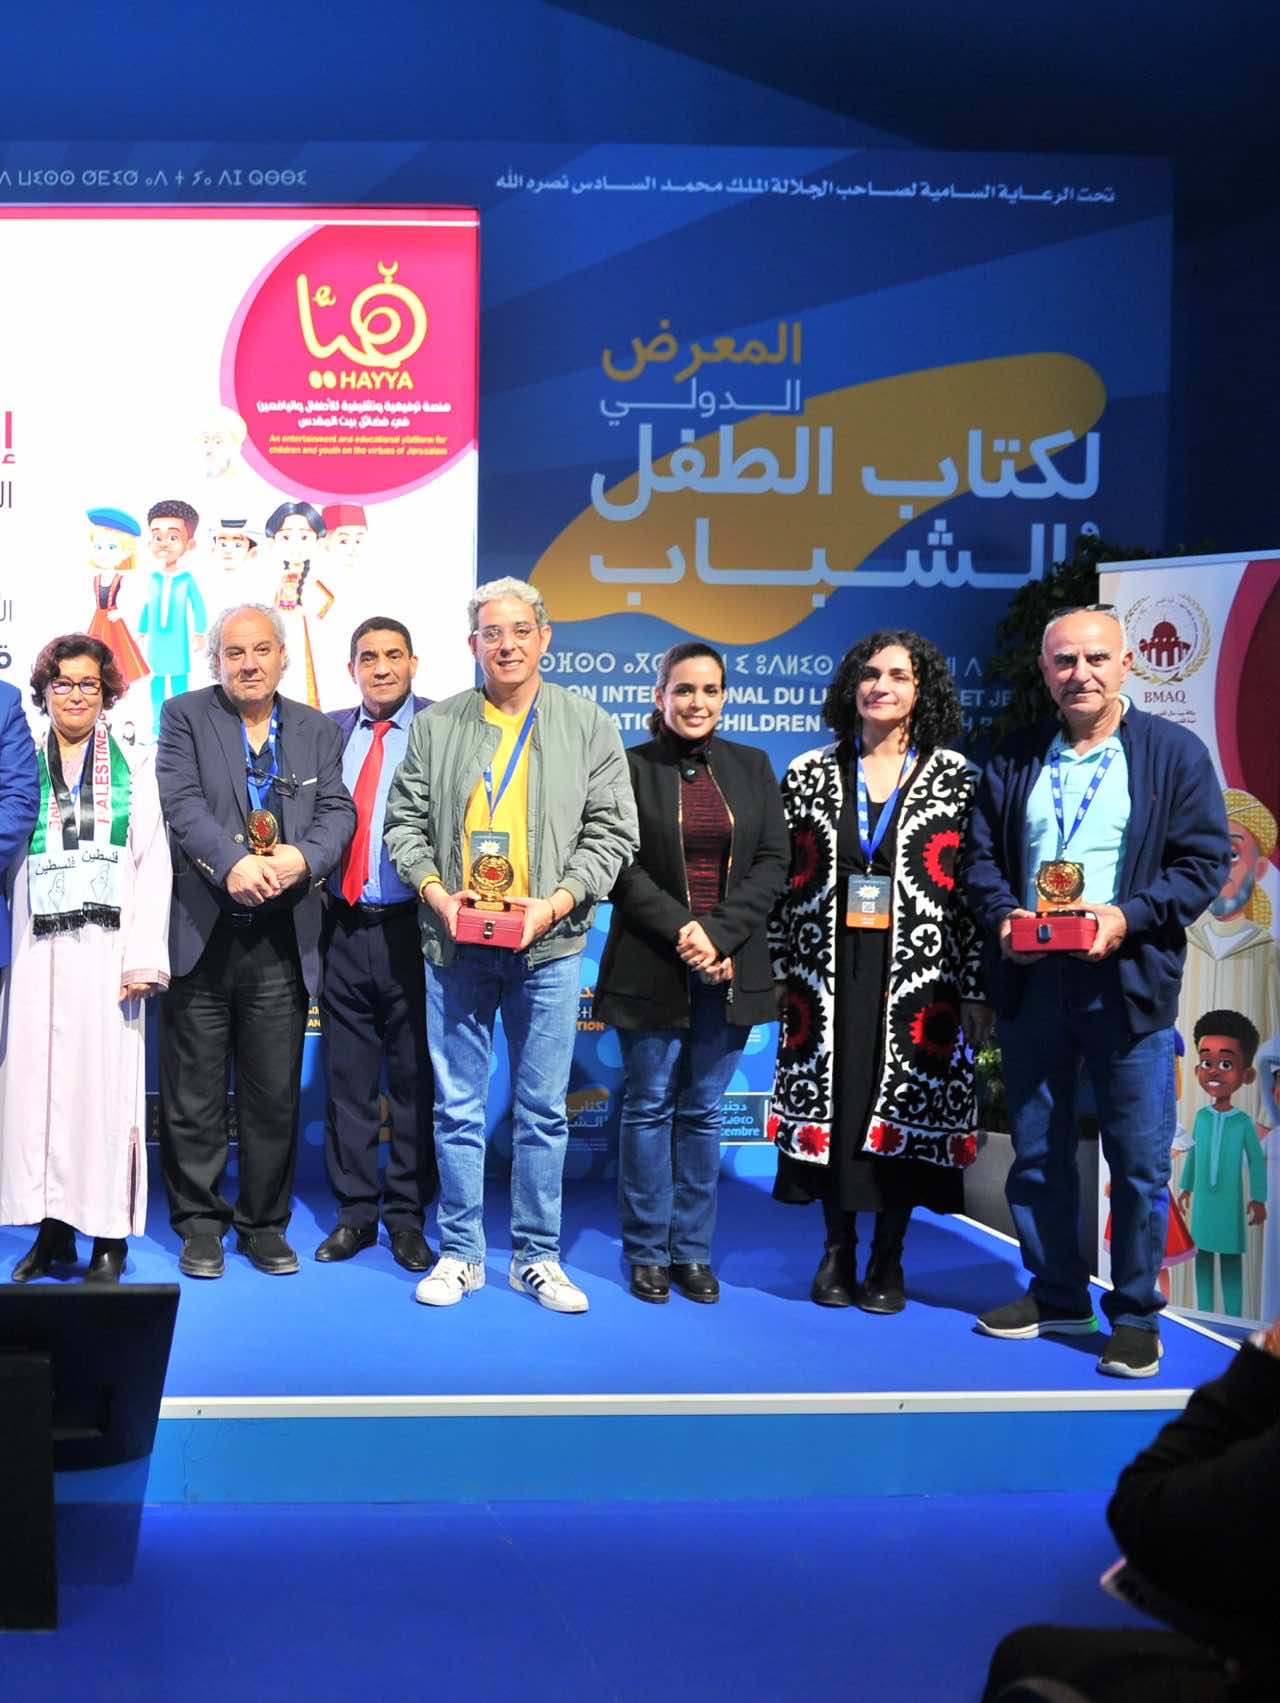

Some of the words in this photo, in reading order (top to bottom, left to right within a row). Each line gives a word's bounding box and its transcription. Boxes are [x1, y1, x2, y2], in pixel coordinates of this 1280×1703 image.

[496, 166, 523, 188] الله
[526, 176, 569, 193] نصره
[572, 176, 657, 194] السادس
[661, 180, 723, 193] محمد
[726, 177, 769, 193] الملك
[772, 177, 833, 200] الجلالة
[836, 181, 917, 201] لصاحب
[921, 183, 995, 201] السامية
[998, 183, 1073, 205] الرعاية
[1077, 186, 1115, 202] تحت
[602, 319, 801, 382] المعرض
[340, 371, 413, 390] HAYYA
[601, 379, 801, 425] الدولي
[590, 423, 833, 520] الطفل
[861, 429, 1101, 519] لكتاب
[774, 687, 803, 705] DU
[960, 689, 984, 706] ET
[1144, 690, 1187, 704] BMAQ
